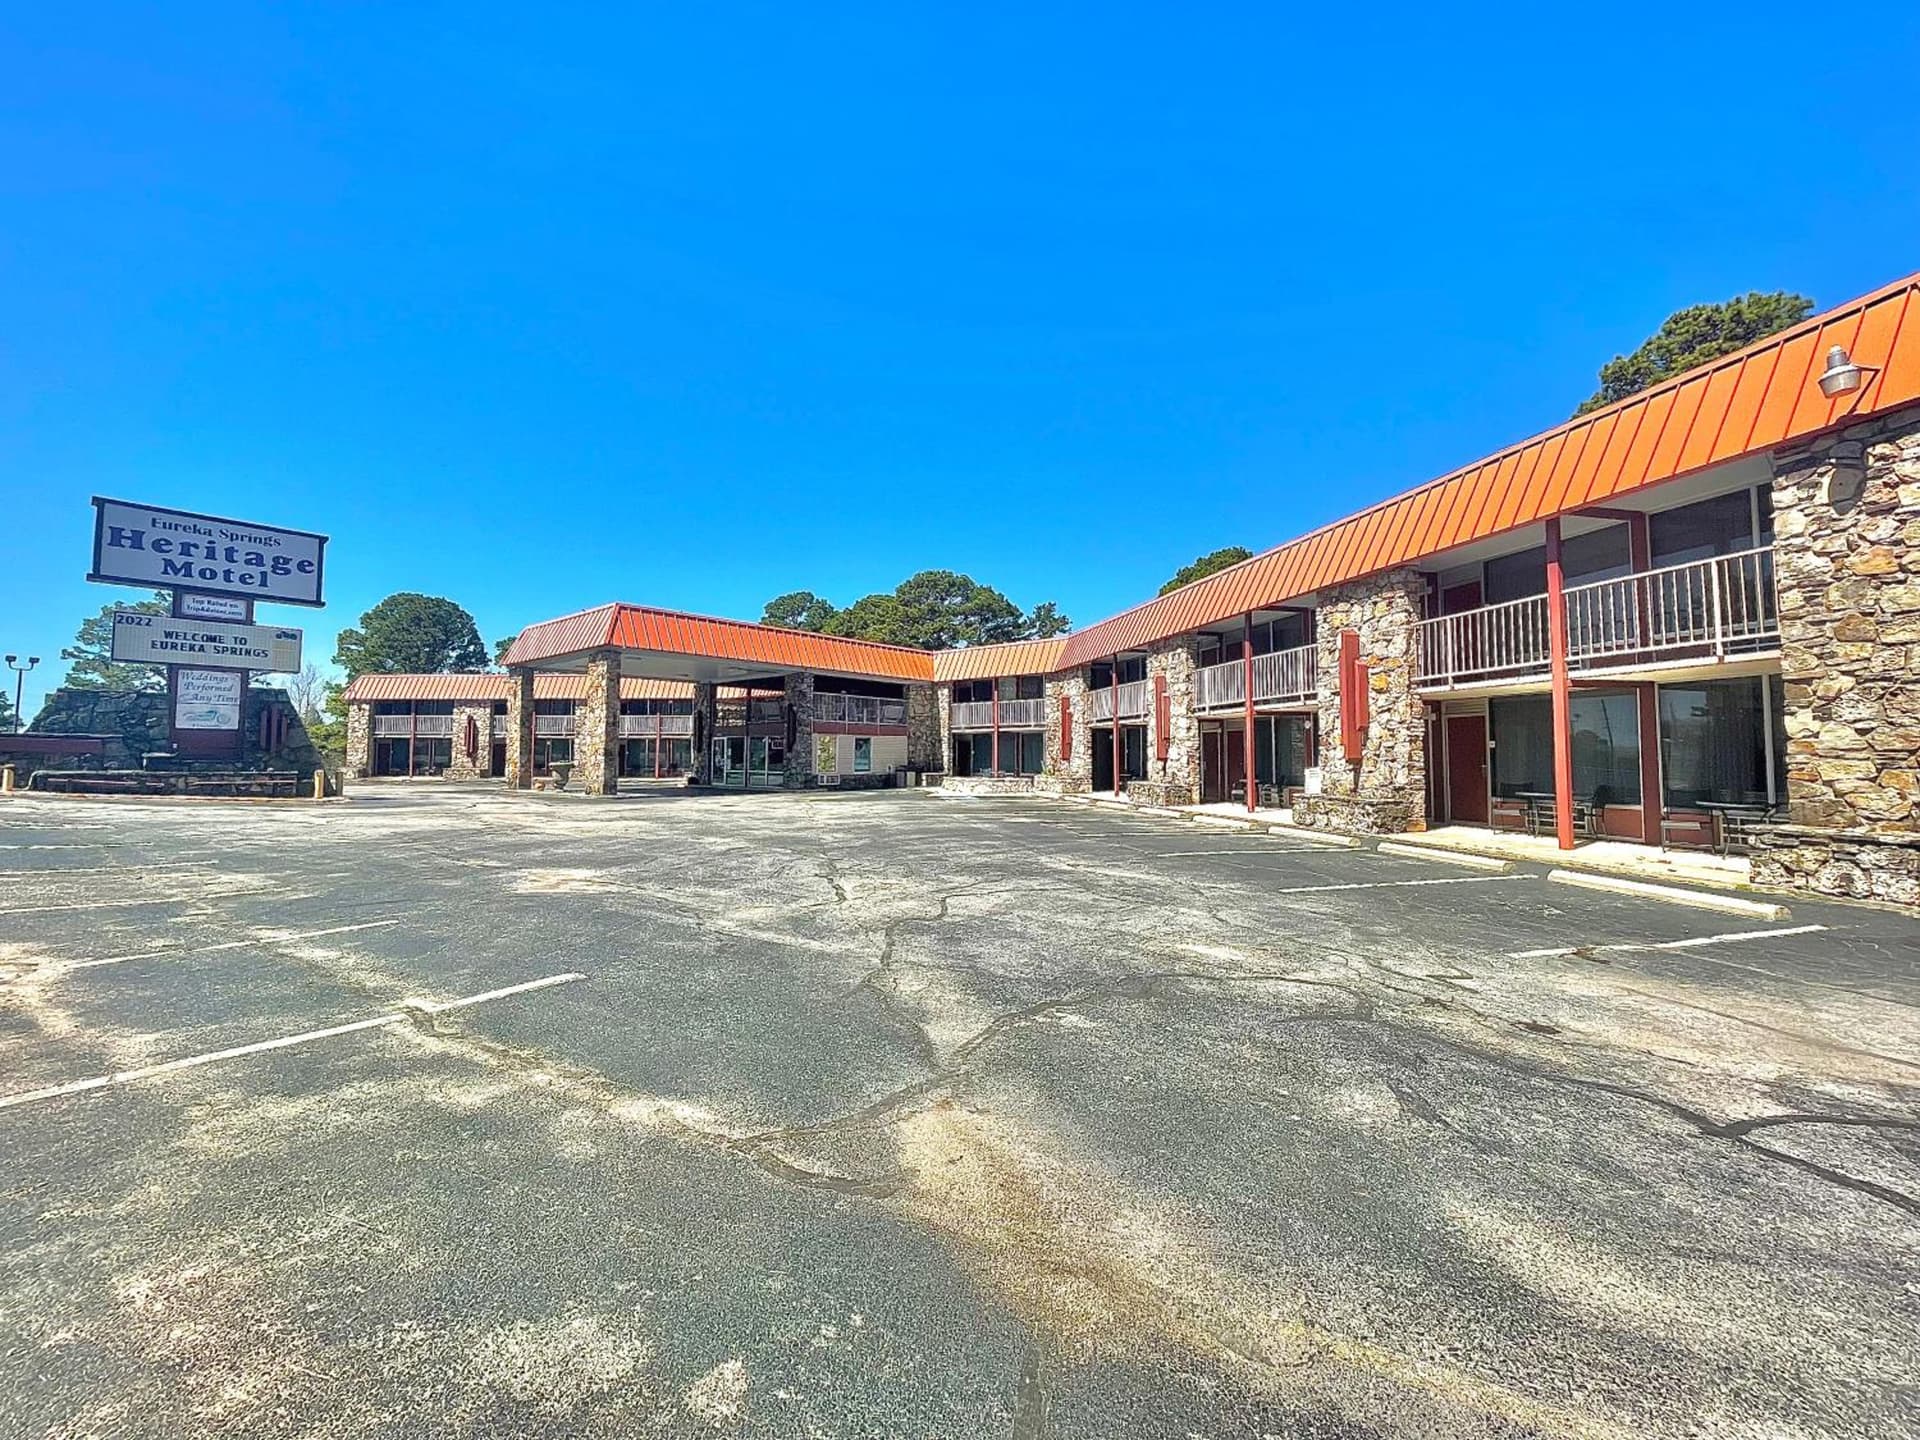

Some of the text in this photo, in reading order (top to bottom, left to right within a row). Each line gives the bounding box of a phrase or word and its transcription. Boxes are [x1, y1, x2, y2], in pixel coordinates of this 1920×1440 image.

[151, 517, 282, 548] Eureka Springs
[107, 525, 315, 577] Heritage
[161, 558, 270, 588] Motel
[191, 597, 205, 606] Top
[116, 614, 153, 627] 2022
[163, 630, 248, 646] WELCOME TO
[151, 640, 269, 658] EUREKA SPRINGS
[180, 671, 229, 684] Weddings
[184, 682, 234, 693] Performed
[192, 693, 238, 703] Any Time
